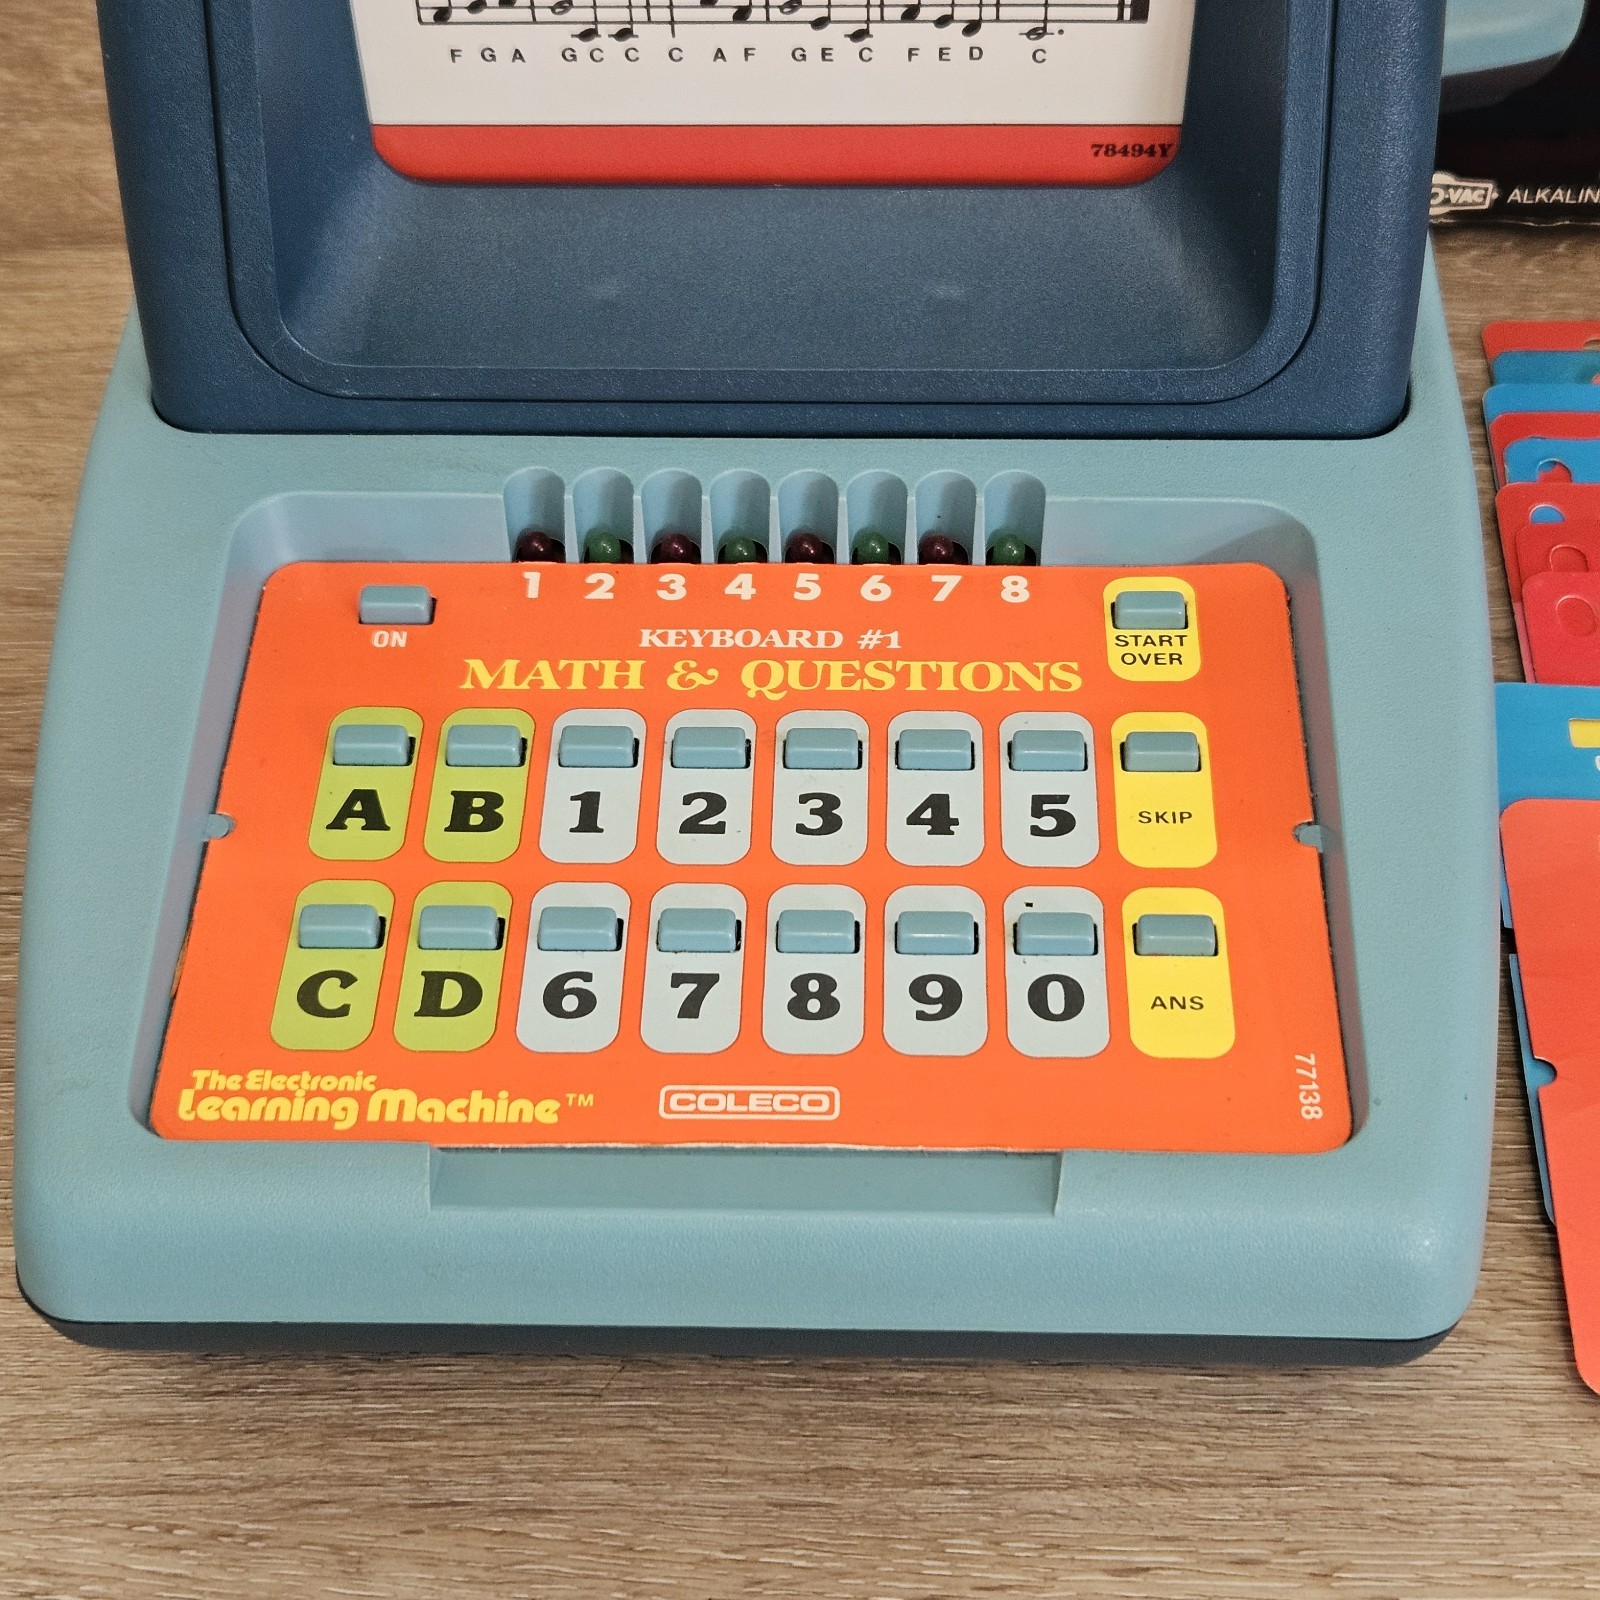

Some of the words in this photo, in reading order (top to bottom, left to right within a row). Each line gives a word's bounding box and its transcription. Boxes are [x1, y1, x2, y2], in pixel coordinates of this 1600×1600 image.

[450, 49, 462, 63] F
[481, 48, 496, 62] G
[512, 49, 525, 62] A
[562, 48, 577, 62] G
[590, 48, 603, 62] C
[625, 48, 639, 62] C
[669, 48, 683, 62] C
[713, 48, 726, 62] A
[744, 48, 755, 61] F
[792, 48, 806, 61] G
[821, 48, 833, 61] E
[859, 47, 872, 62] C
[908, 48, 919, 62] F
[939, 47, 950, 61] E
[969, 47, 983, 60] D
[1032, 49, 1046, 63] C
[1090, 143, 1174, 159] 78494Y
[524, 572, 540, 598] 1
[585, 573, 615, 599] 2
[657, 574, 686, 600] 3
[725, 574, 756, 600] 4
[794, 573, 821, 600] 5
[861, 575, 891, 601] 6
[932, 575, 962, 601] 7
[1001, 576, 1029, 603] 8
[374, 631, 407, 647] ON
[640, 629, 843, 648] KEYBOARD
[858, 629, 901, 649] #1
[1115, 635, 1187, 647] START
[1121, 653, 1182, 665] OVER
[460, 658, 646, 689] MATH
[667, 659, 718, 690] &
[741, 659, 1082, 700] QUESTIONS
[326, 789, 390, 831] A
[444, 791, 504, 832] B
[569, 791, 604, 833] 1
[679, 792, 726, 834] 2
[796, 793, 842, 836] 3
[906, 794, 959, 835] 4
[1030, 795, 1076, 837] 5
[1139, 811, 1192, 823] SKIP
[297, 970, 358, 1018] C
[414, 971, 483, 1017] D
[543, 971, 597, 1019] 6
[671, 973, 719, 1019] 7
[787, 973, 840, 1020] 8
[909, 974, 962, 1021] 9
[1028, 974, 1084, 1022] 0
[1151, 996, 1204, 1010] ANS
[192, 1070, 242, 1090] The
[245, 1070, 377, 1091] Electronic
[1295, 1054, 1323, 1119] 77138
[178, 1089, 359, 1130] Learning
[367, 1090, 561, 1124] Machine
[669, 1092, 830, 1113] COLECO
